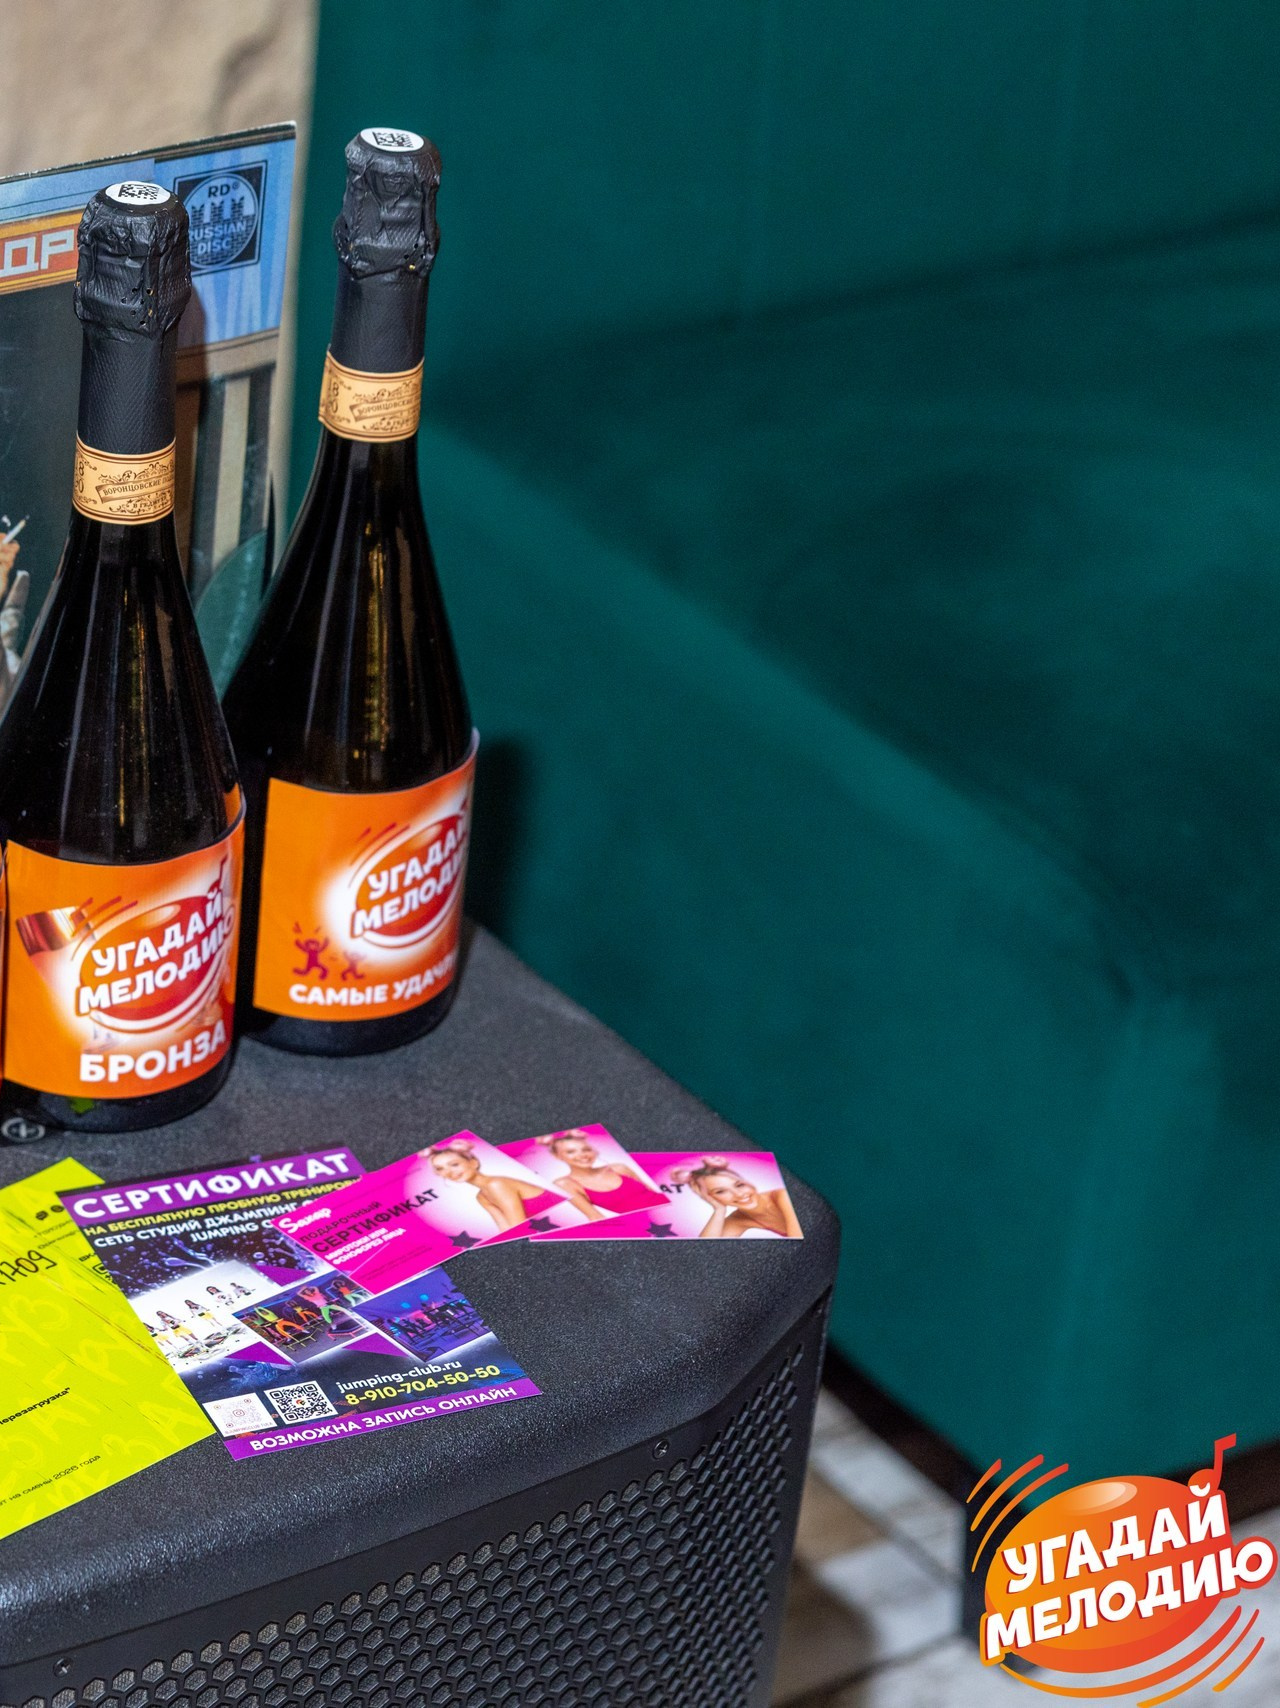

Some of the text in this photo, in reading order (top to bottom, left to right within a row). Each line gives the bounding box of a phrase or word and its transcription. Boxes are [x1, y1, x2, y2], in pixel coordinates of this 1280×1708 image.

[197, 237, 232, 256] DISC
[91, 887, 223, 977] УГАДАЙ
[79, 904, 234, 1015] МЕЛОДИЮ
[289, 983, 389, 1006] САМЫЕ
[80, 1019, 227, 1083] БРОНЗА
[73, 1152, 352, 1218] СЕРТИФИКАТ
[84, 1225, 108, 1237] НА
[109, 1206, 206, 1233] БЕСПЛАТНУЮ
[207, 1193, 282, 1213] ПРОБНУЮ
[93, 1233, 135, 1248] СЕТЬ
[136, 1218, 205, 1240] СТУДИЙ
[205, 1201, 298, 1229] ДЖАМПИНГ
[190, 1220, 259, 1243] JUMPING
[299, 1201, 382, 1243] ПОДАРОЧНЫЙ
[312, 1188, 439, 1253] СЕРТИФИКАТ
[335, 1359, 462, 1394] jumping-club.ru
[344, 1365, 501, 1406] 8-910-704-50-50
[249, 1387, 518, 1451] ВОЗМОЖНА ЗАПИСЬ ОНЛАЙН
[8, 1492, 22, 1501] на
[22, 1477, 53, 1495] смены
[52, 1464, 79, 1480] 2026
[79, 1454, 101, 1468] года
